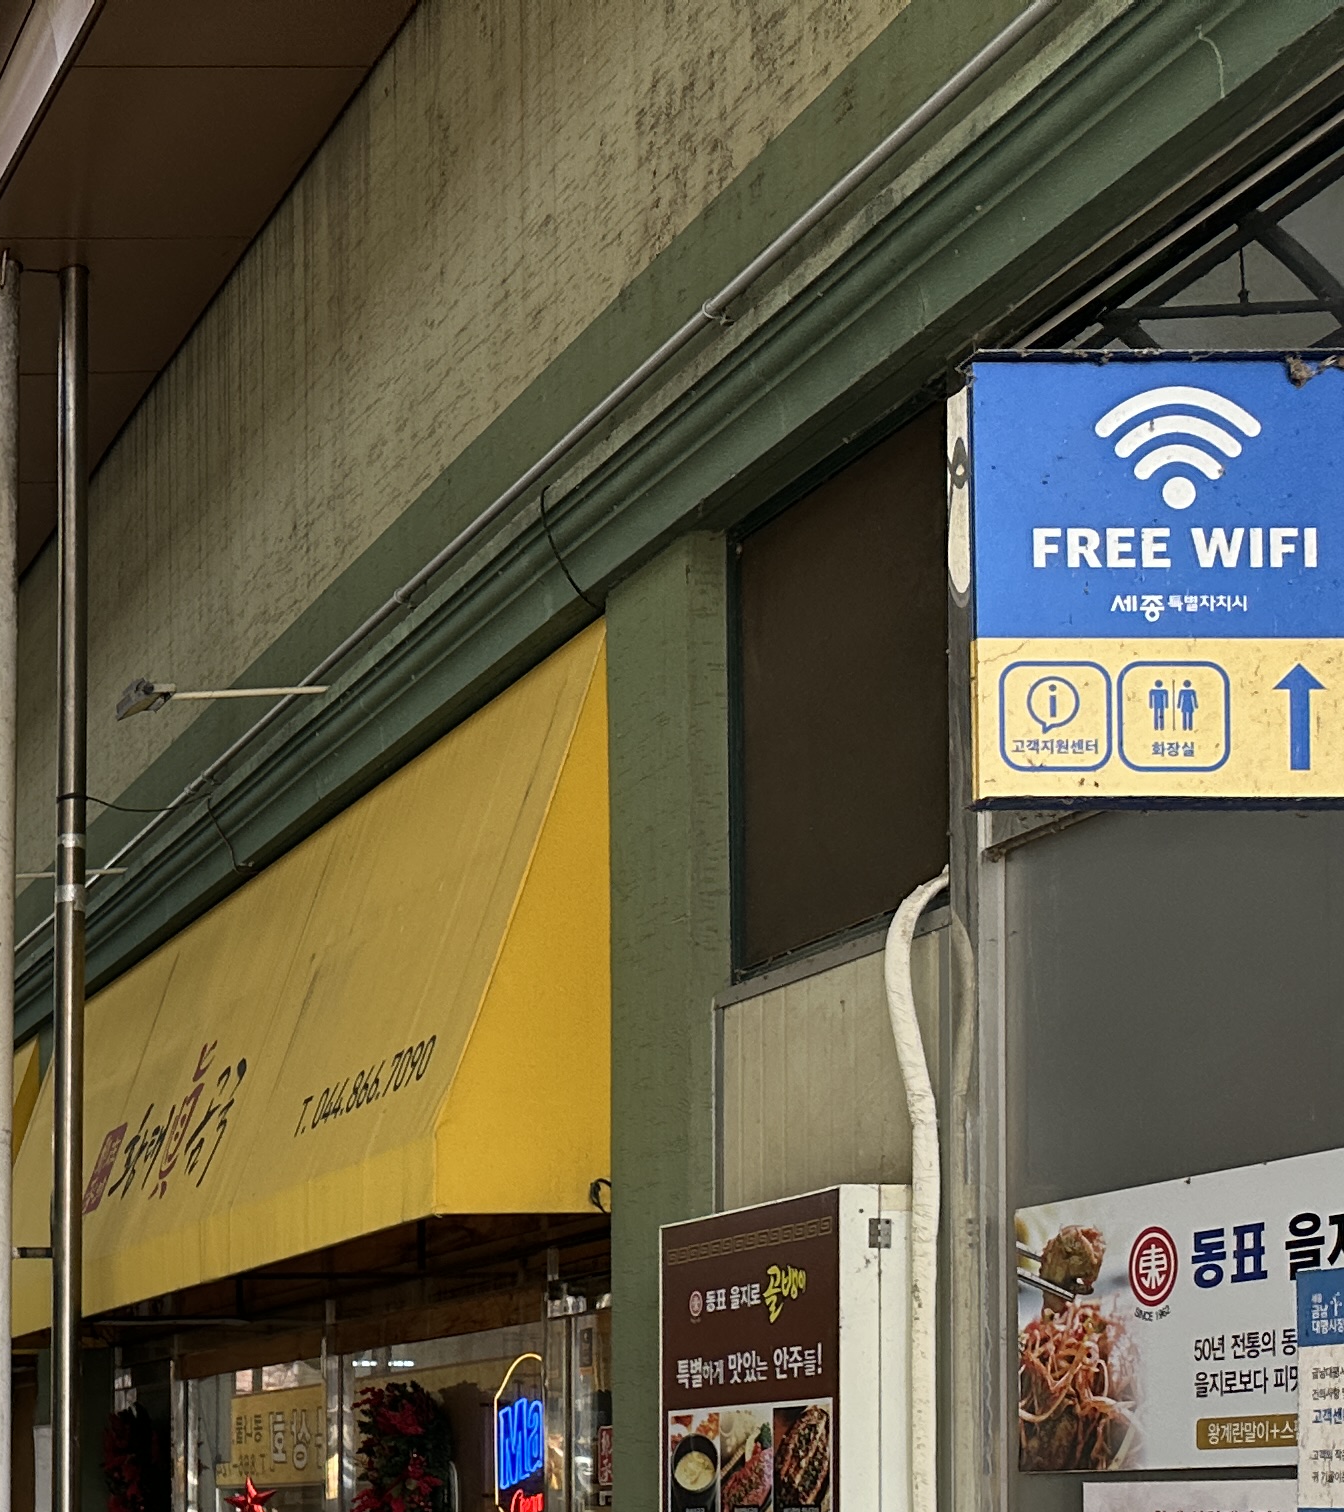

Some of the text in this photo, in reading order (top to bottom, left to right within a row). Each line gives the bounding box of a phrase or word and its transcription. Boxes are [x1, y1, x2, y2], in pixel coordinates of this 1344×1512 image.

[1032, 527, 1318, 569] FREE WIFI
[1011, 738, 1099, 755] 고객지원센터
[1151, 740, 1196, 758] 화장실
[1192, 1222, 1268, 1289] 동표
[705, 1264, 807, 1323] 동표 을지로 골뱅이
[676, 1342, 823, 1390] 특별하게 맛있는 안주들!
[1193, 1329, 1298, 1362] 50년 전통의 동
[1193, 1368, 1269, 1399] 을지로보다
[498, 1397, 544, 1490] Ma
